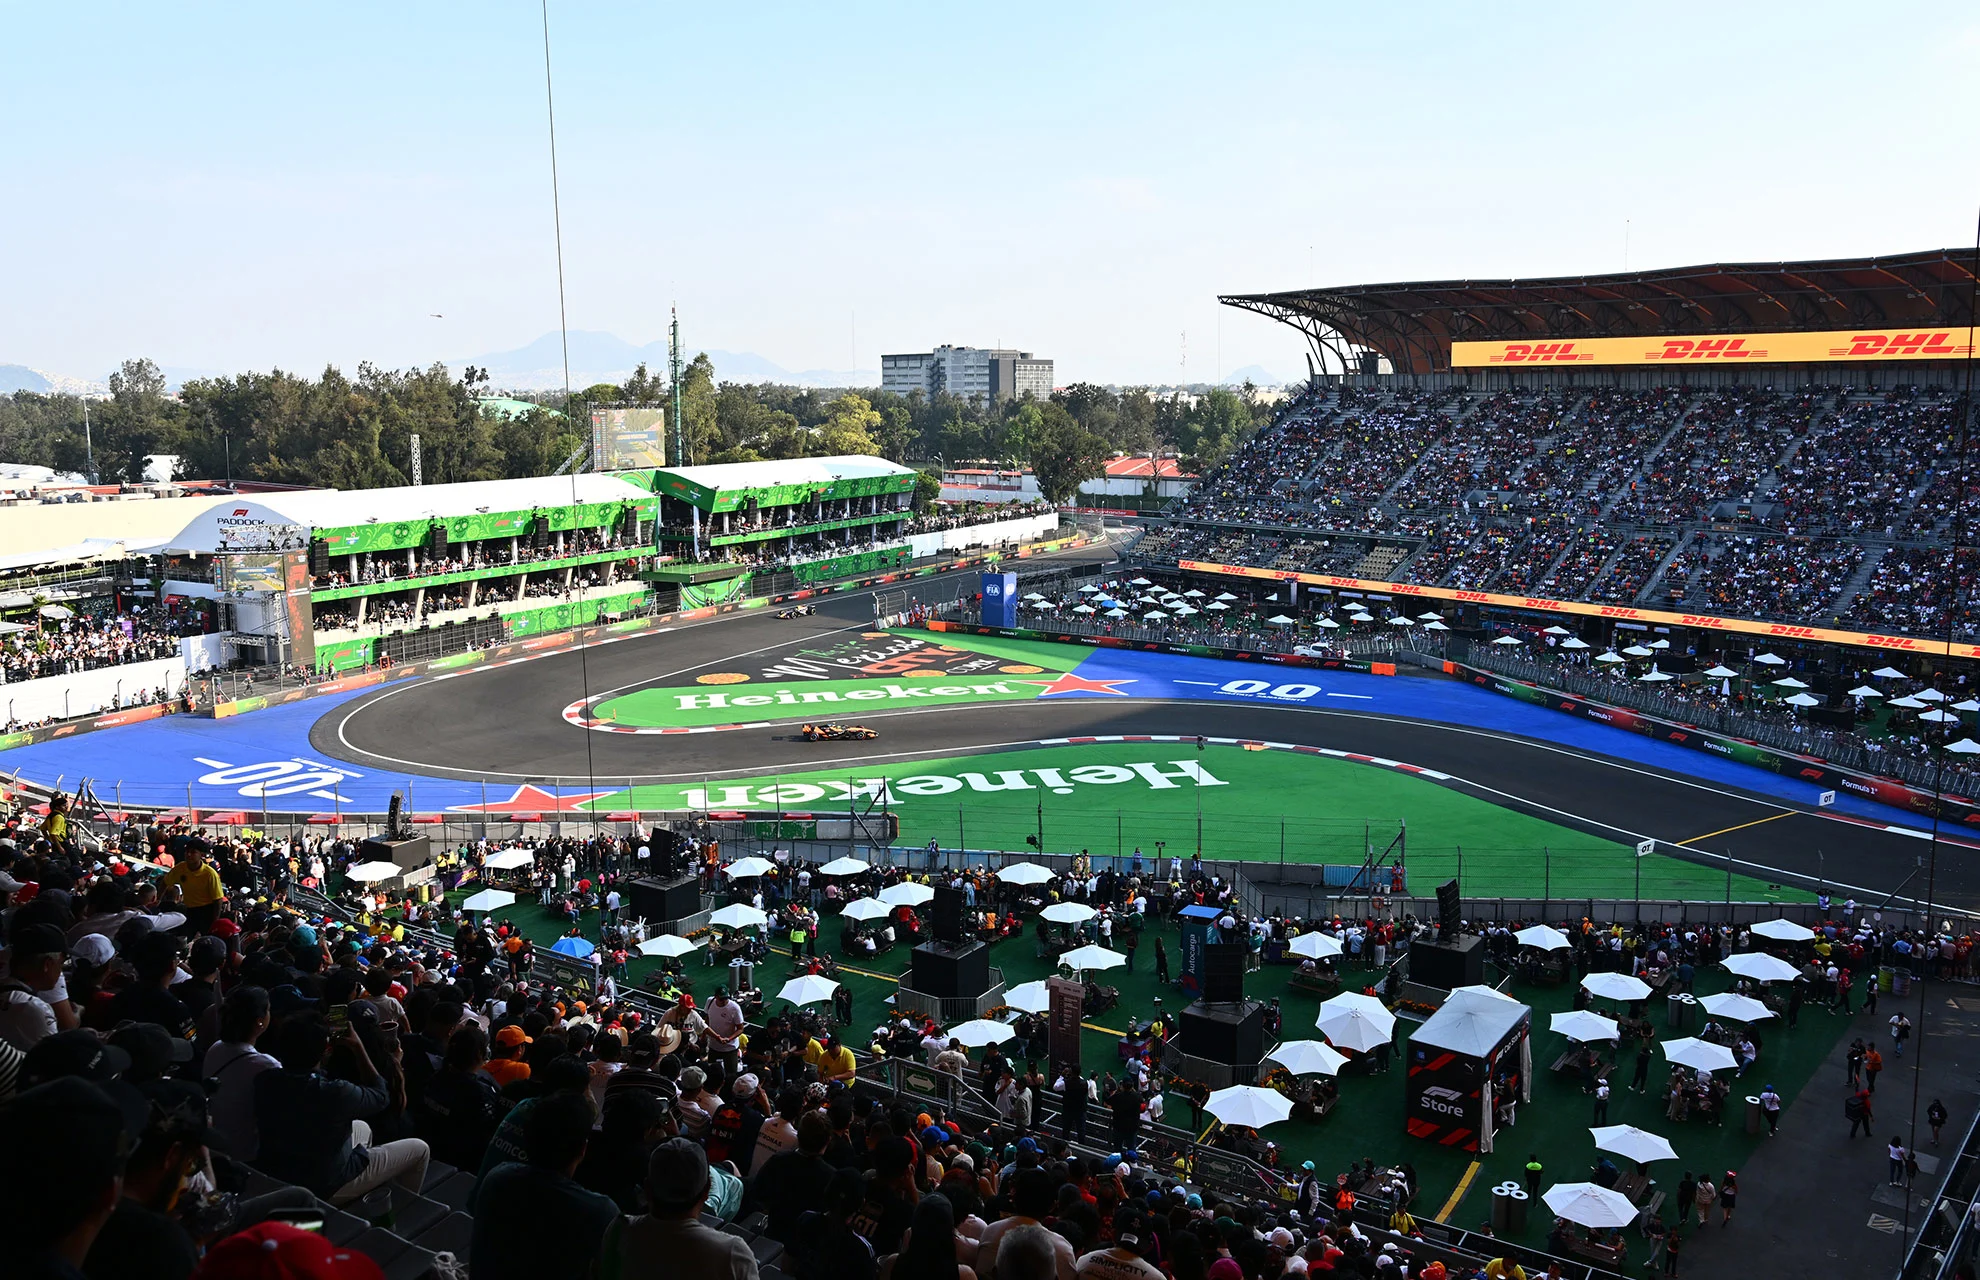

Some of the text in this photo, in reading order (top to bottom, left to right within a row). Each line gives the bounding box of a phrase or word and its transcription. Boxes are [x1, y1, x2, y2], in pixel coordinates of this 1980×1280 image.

[1660, 339, 1752, 359] DHL
[1848, 333, 1955, 355] DHL
[1503, 343, 1581, 361] DHL
[217, 517, 265, 526] PADDOCK
[1179, 561, 1196, 569] HL
[1222, 566, 1247, 575] DHL
[1331, 578, 1359, 587] DHL
[1391, 584, 1422, 595] DHL
[1456, 591, 1489, 602] DHL
[1525, 598, 1561, 610] DHL
[1600, 606, 1640, 619] DHL
[1681, 615, 1723, 628] DHL
[1769, 624, 1817, 639] DHL
[1866, 635, 1917, 650] DHL
[1494, 682, 1510, 693] Formula
[674, 684, 1018, 710] Heineken
[1588, 709, 1608, 720] Formula
[1703, 740, 1726, 753] Formula
[678, 760, 1229, 808] Heineken
[1841, 779, 1870, 793] Formula
[1824, 795, 1832, 803] OT
[1641, 844, 1651, 853] OT
[1188, 934, 1196, 974] Autocarga
[1422, 1086, 1463, 1101] F1
[1421, 1096, 1464, 1118] Store
[494, 1135, 529, 1162] ramco
[1089, 1255, 1147, 1278] SIMPLICITY
